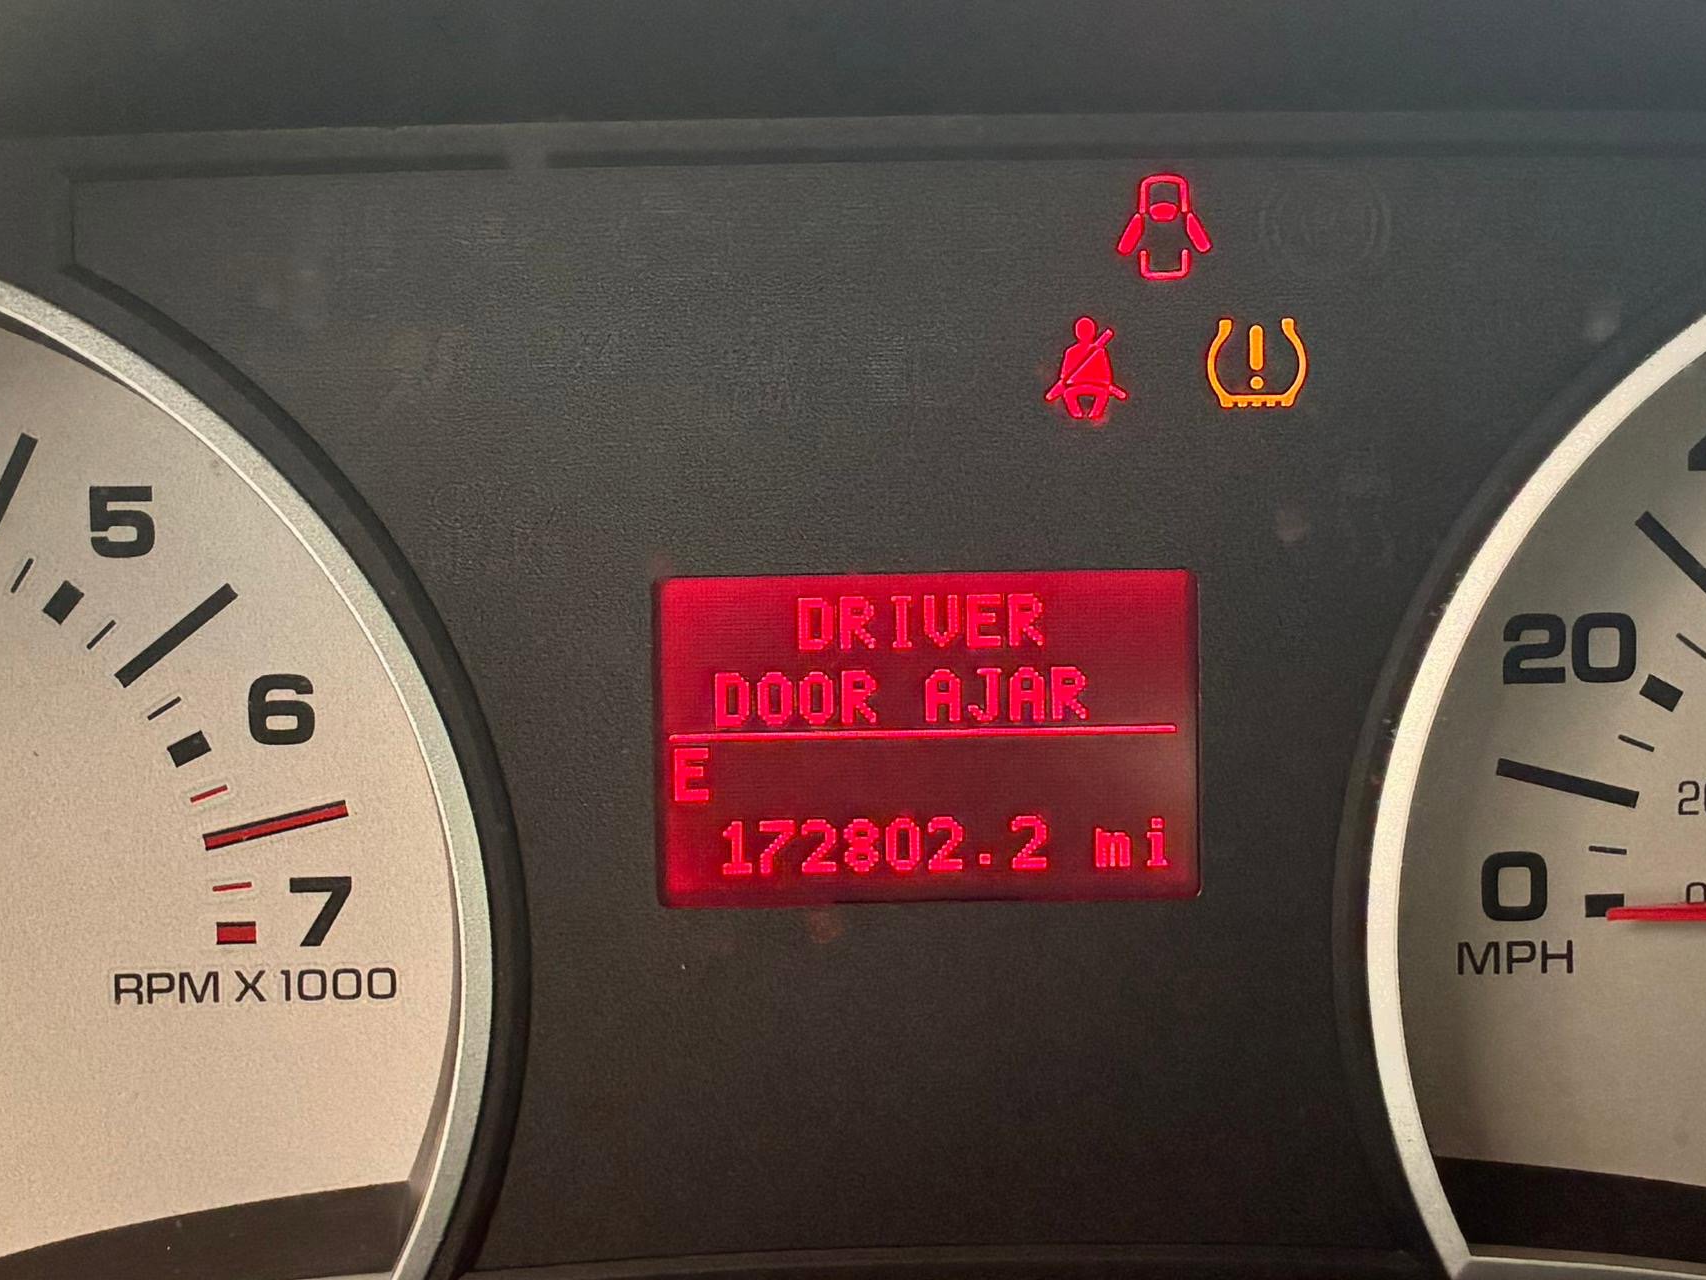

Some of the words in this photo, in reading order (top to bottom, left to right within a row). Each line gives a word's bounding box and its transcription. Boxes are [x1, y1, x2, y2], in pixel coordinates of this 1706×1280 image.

[89, 486, 155, 558] 5
[797, 593, 1046, 651] DRIVER
[1502, 613, 1636, 685] 20
[248, 674, 315, 745] 6
[714, 668, 878, 728] DOOR
[925, 665, 1089, 722] AJAR
[673, 747, 710, 803] E
[722, 816, 1049, 875] 172802.2
[1095, 818, 1168, 868] mi
[290, 876, 351, 947] 7
[1481, 852, 1547, 922] 0
[114, 972, 219, 1005] RPM
[235, 970, 265, 1002] X
[281, 968, 396, 1001] 1000
[1457, 941, 1573, 976] MPH
